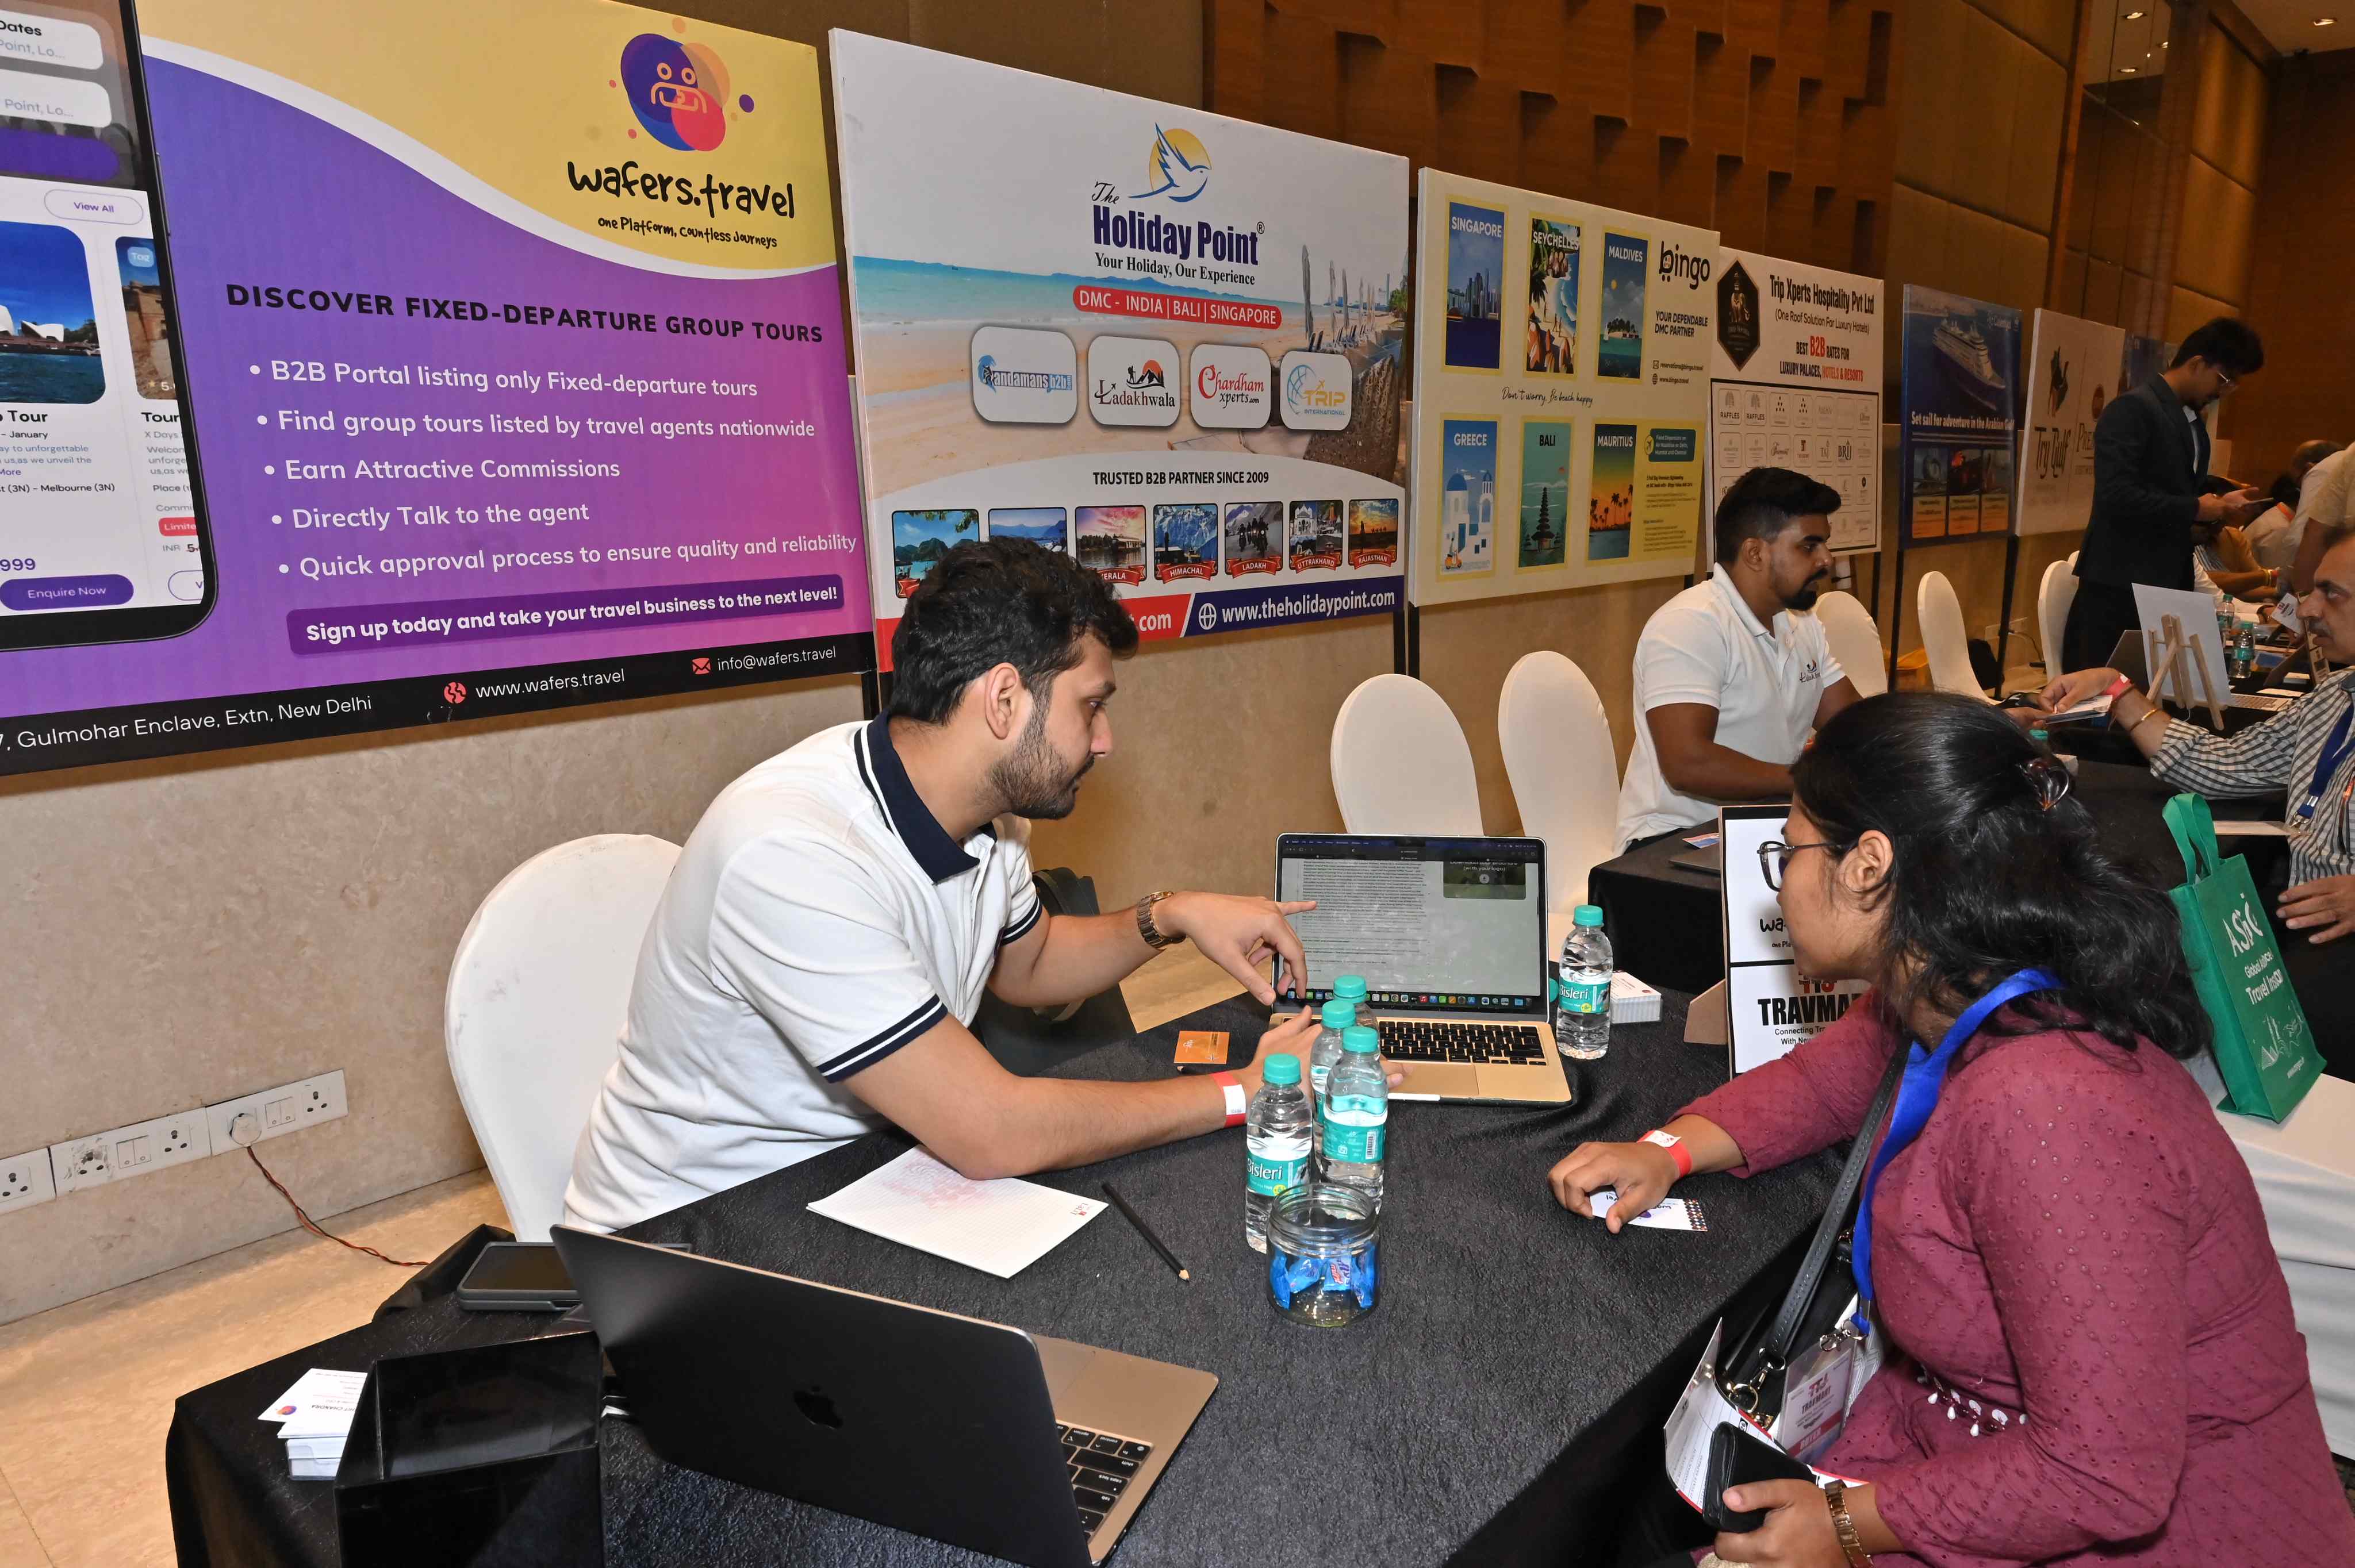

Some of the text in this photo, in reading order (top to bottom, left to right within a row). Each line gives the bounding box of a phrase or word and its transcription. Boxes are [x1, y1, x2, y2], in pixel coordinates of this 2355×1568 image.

[567, 161, 795, 218] wafers.travel
[1092, 180, 1120, 205] The
[74, 202, 114, 213] View All
[620, 216, 677, 238] Platform,
[1093, 205, 1259, 266] Holiday Point
[1452, 216, 1502, 238] SINGAPORE
[1533, 231, 1579, 250] SEYCHELLES
[1609, 245, 1643, 262] MALDIVES
[1095, 252, 1256, 285] Your Holiday, Our Experience
[1659, 240, 1710, 290] bingo
[1770, 275, 1874, 314] Trip Xperts Hospitality Pvt Ltd
[227, 284, 823, 343] DISCOVER FIXED-DEPARTURE GROUP TOURS
[1080, 290, 1276, 325] DMC INDIA BALI SINGAPORE
[1656, 310, 1708, 326] YOUR DEPENDABLE
[1655, 324, 1694, 337] DMC PARTNER
[1775, 309, 1789, 322] (One
[1790, 311, 1802, 323] Roof
[1804, 313, 1825, 326] Solution
[1835, 318, 1852, 331] Luxury
[1796, 336, 1850, 360] BEST B2B RATES FOR
[271, 360, 757, 397] B2B Portal listing only Fixed-departure tours
[1198, 364, 1264, 399] Chardham
[1780, 362, 1798, 375] LUXURY
[1822, 366, 1839, 380] HOTELS
[1844, 368, 1863, 382] RESORTS
[1094, 379, 1176, 407] Ladakhwala
[1303, 390, 1346, 407] TRIP
[1576, 393, 1593, 408] happy
[7, 410, 48, 422] Tour
[141, 412, 179, 422] Tour
[278, 410, 815, 439] Find group tours listed by travel agents nationwide
[1911, 411, 1921, 425] Set
[10, 431, 48, 440] January
[1454, 433, 1487, 447] GREECE
[1539, 435, 1556, 447] BALI
[1597, 435, 1633, 448] MAURITIUS
[26, 445, 89, 453] unforgettable
[285, 459, 620, 479] Earn Attractive Commissions
[1093, 471, 1269, 485] TRUSTED B2B PARTNER SINCE 2009
[41, 484, 91, 492] Melbourne
[94, 483, 115, 491] (3N)
[293, 504, 589, 531] Directly Talk to the agent
[300, 533, 857, 581] Quick approval process to ensure quality and reliability
[1242, 562, 1267, 571] LADAKH
[1297, 558, 1334, 569] UTTRAKHAND
[1357, 555, 1388, 563] RAJASTHAN
[1170, 567, 1203, 577] HIMACHAL
[27, 587, 106, 599] Enquire Now
[306, 587, 838, 644] Sign up today and take your travel business to the next level!
[1222, 590, 1395, 623] www.theholidaypoint.com
[717, 646, 837, 671] info@wafers.travel
[475, 668, 626, 698] www.wafers.travel
[17, 695, 372, 748] Gulmohar Enclave, Extn, New Delhi
[1559, 983, 1589, 1000] Bisleri
[2245, 977, 2269, 1005] Travel
[1758, 993, 1863, 1025] TRAVMA
[1775, 1027, 1813, 1035] Connecting
[1247, 1158, 1283, 1180] Bisleri
